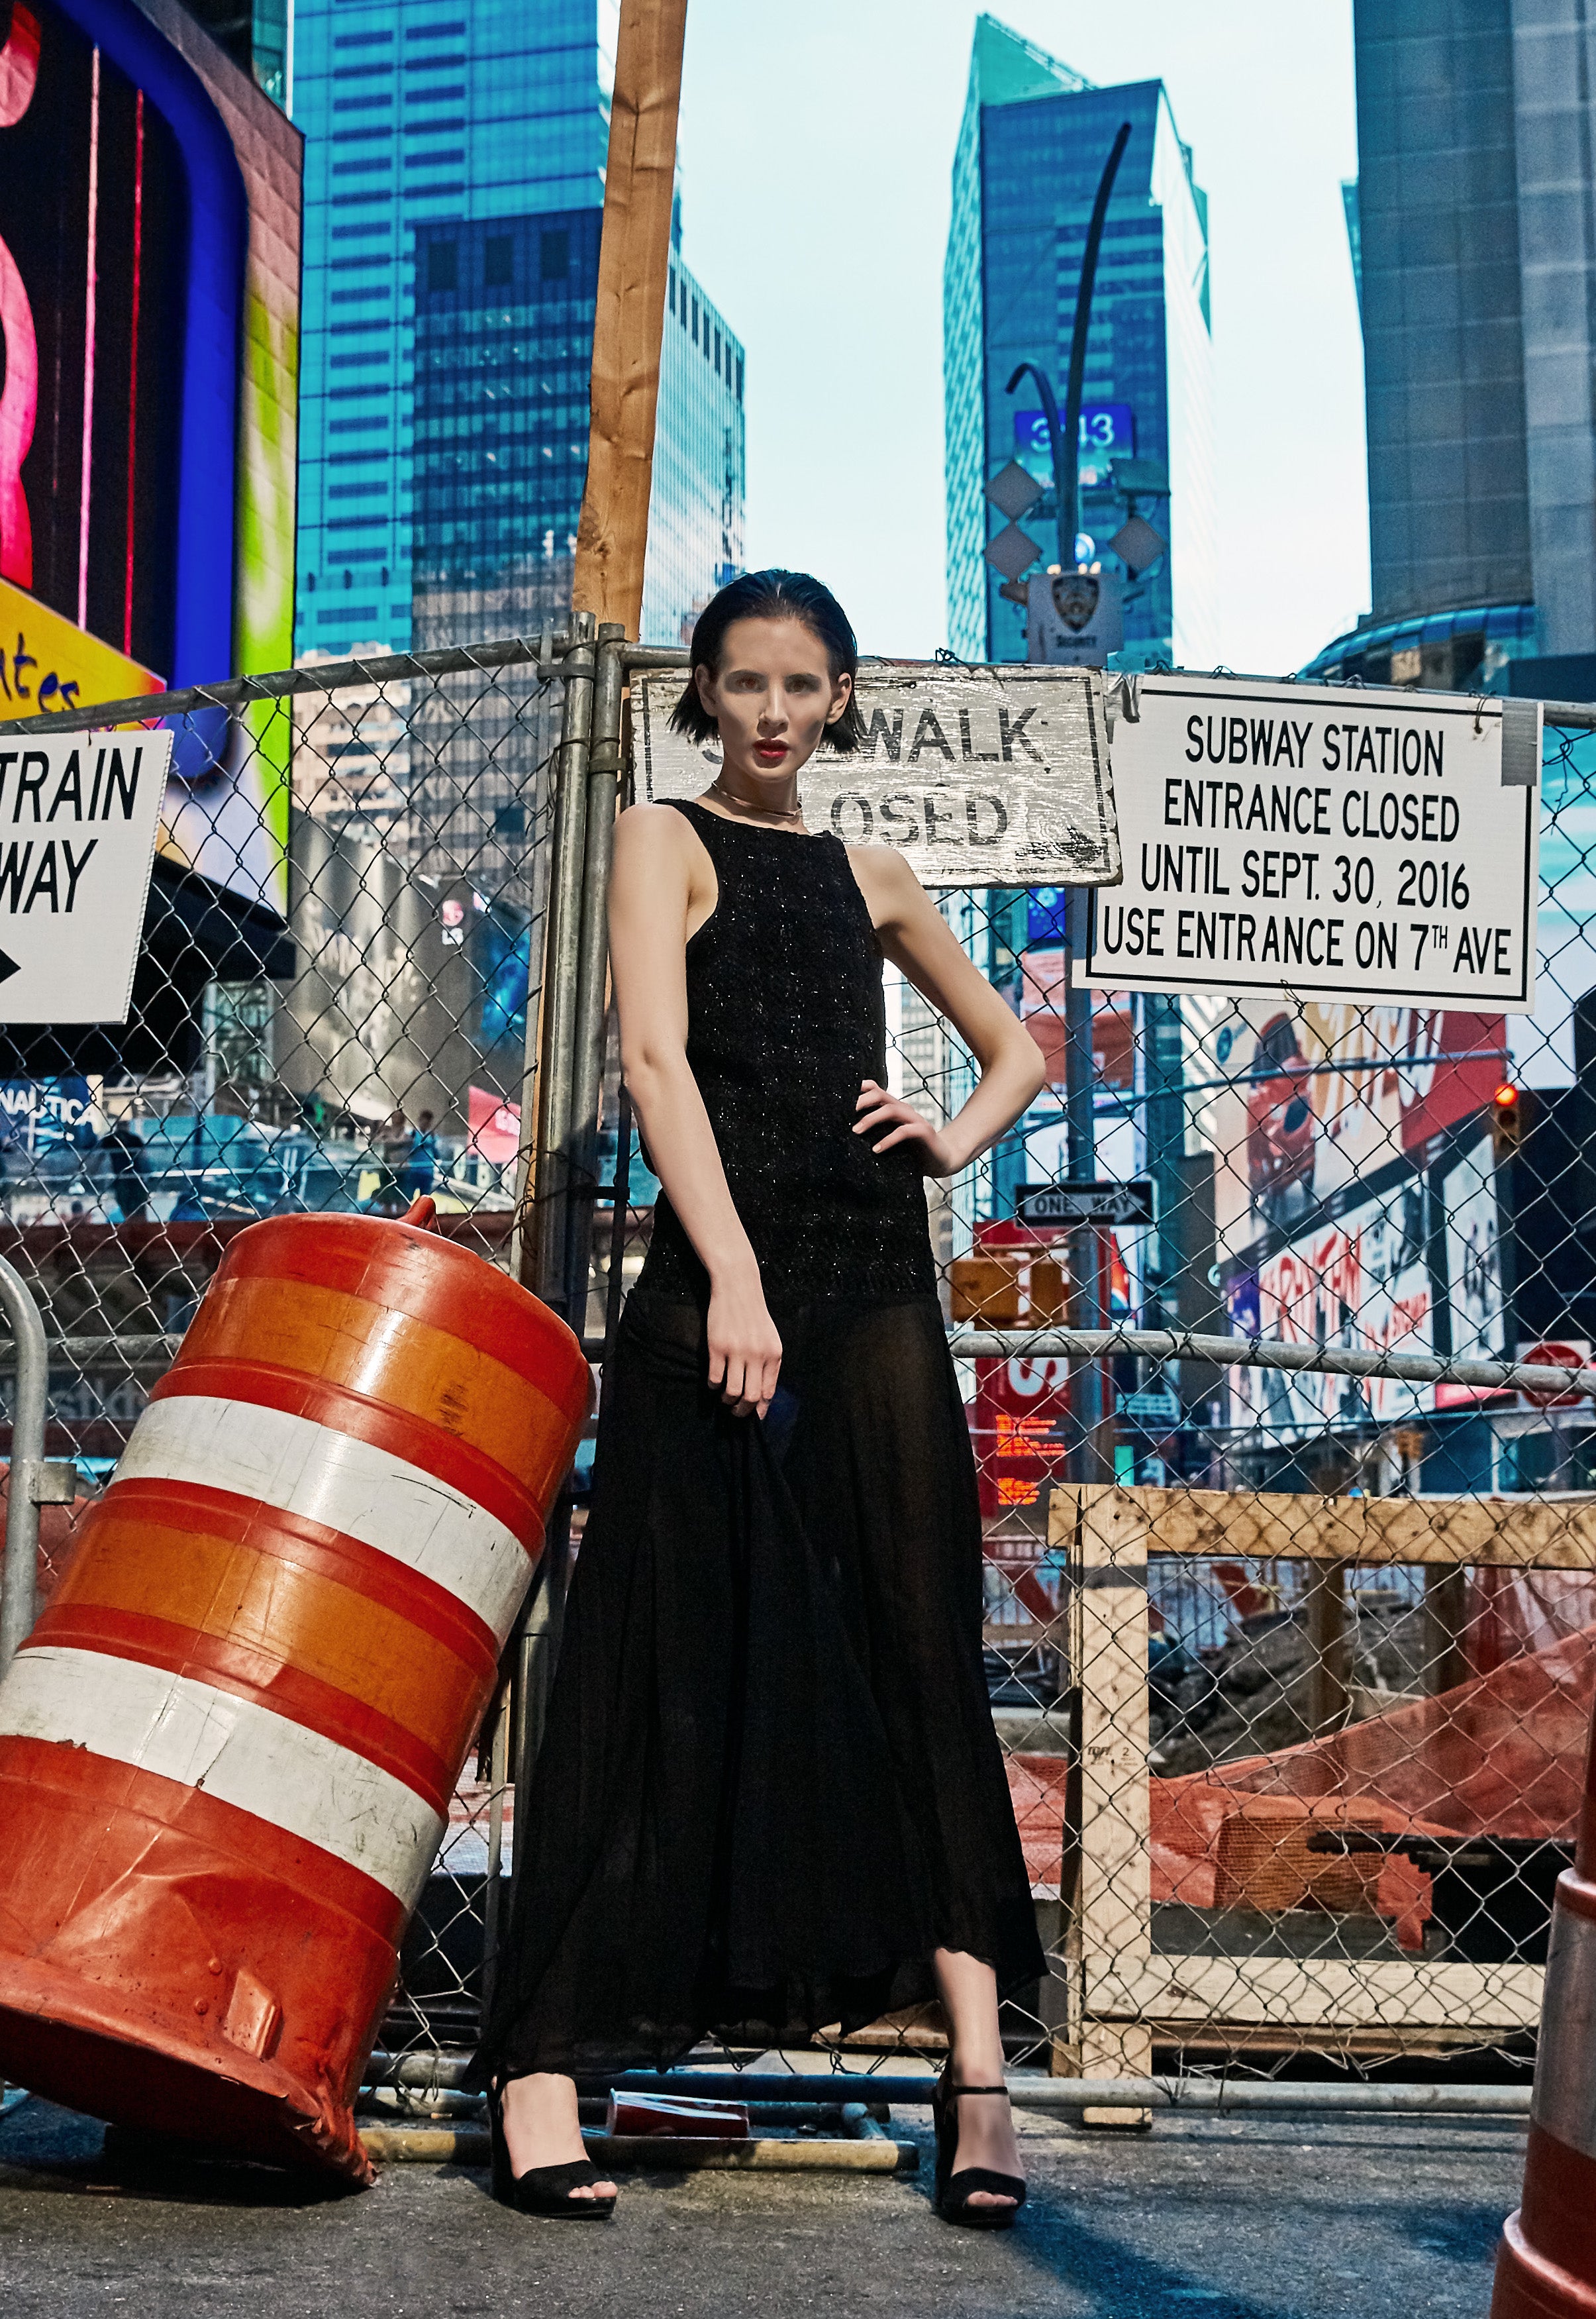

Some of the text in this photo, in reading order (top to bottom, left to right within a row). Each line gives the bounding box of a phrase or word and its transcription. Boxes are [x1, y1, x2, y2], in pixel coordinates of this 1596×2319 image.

[1185, 715, 1444, 777] SUBWAY STATION
[830, 792, 1007, 847] OSED
[1164, 778, 1460, 843] ENTRANCE CLOSED
[1141, 843, 1470, 910] UNTIL SEPT. 30, 2016
[1104, 905, 1511, 976] USE ENTRANCE ON 7TH AVE
[0, 1086, 111, 1137] NAUTICA
[1034, 1194, 1129, 1215] ONE WAY
